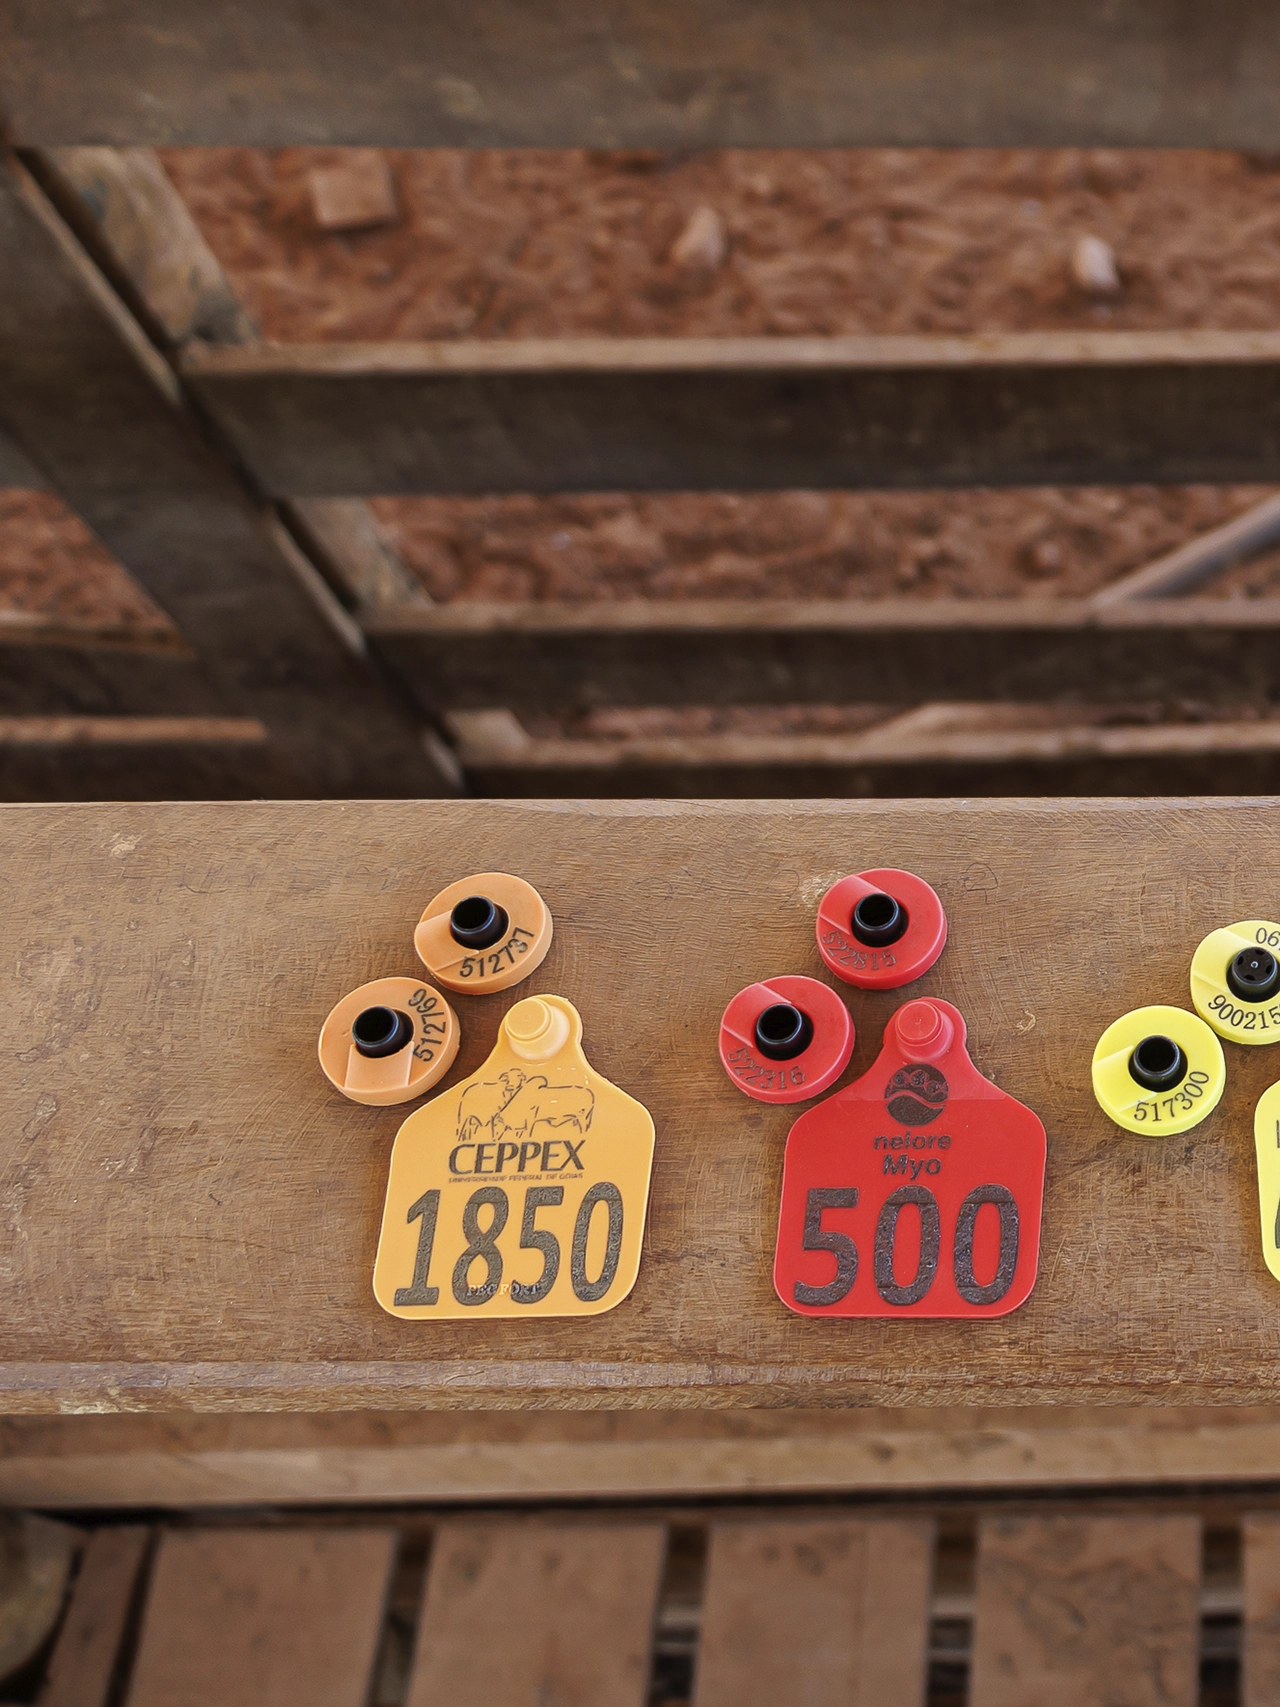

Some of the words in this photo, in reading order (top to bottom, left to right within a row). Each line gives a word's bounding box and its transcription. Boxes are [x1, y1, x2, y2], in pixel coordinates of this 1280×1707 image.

[459, 927, 535, 978] 512737
[821, 931, 897, 970] 522815
[408, 988, 447, 1062] 512766
[727, 1047, 806, 1090] 522316
[1133, 1070, 1210, 1122] 517300
[448, 1139, 586, 1175] CEPPEX
[873, 1130, 952, 1151] nelore
[882, 1153, 942, 1181] Myo
[393, 1182, 624, 1306] 1850
[794, 1183, 1020, 1306] 500
